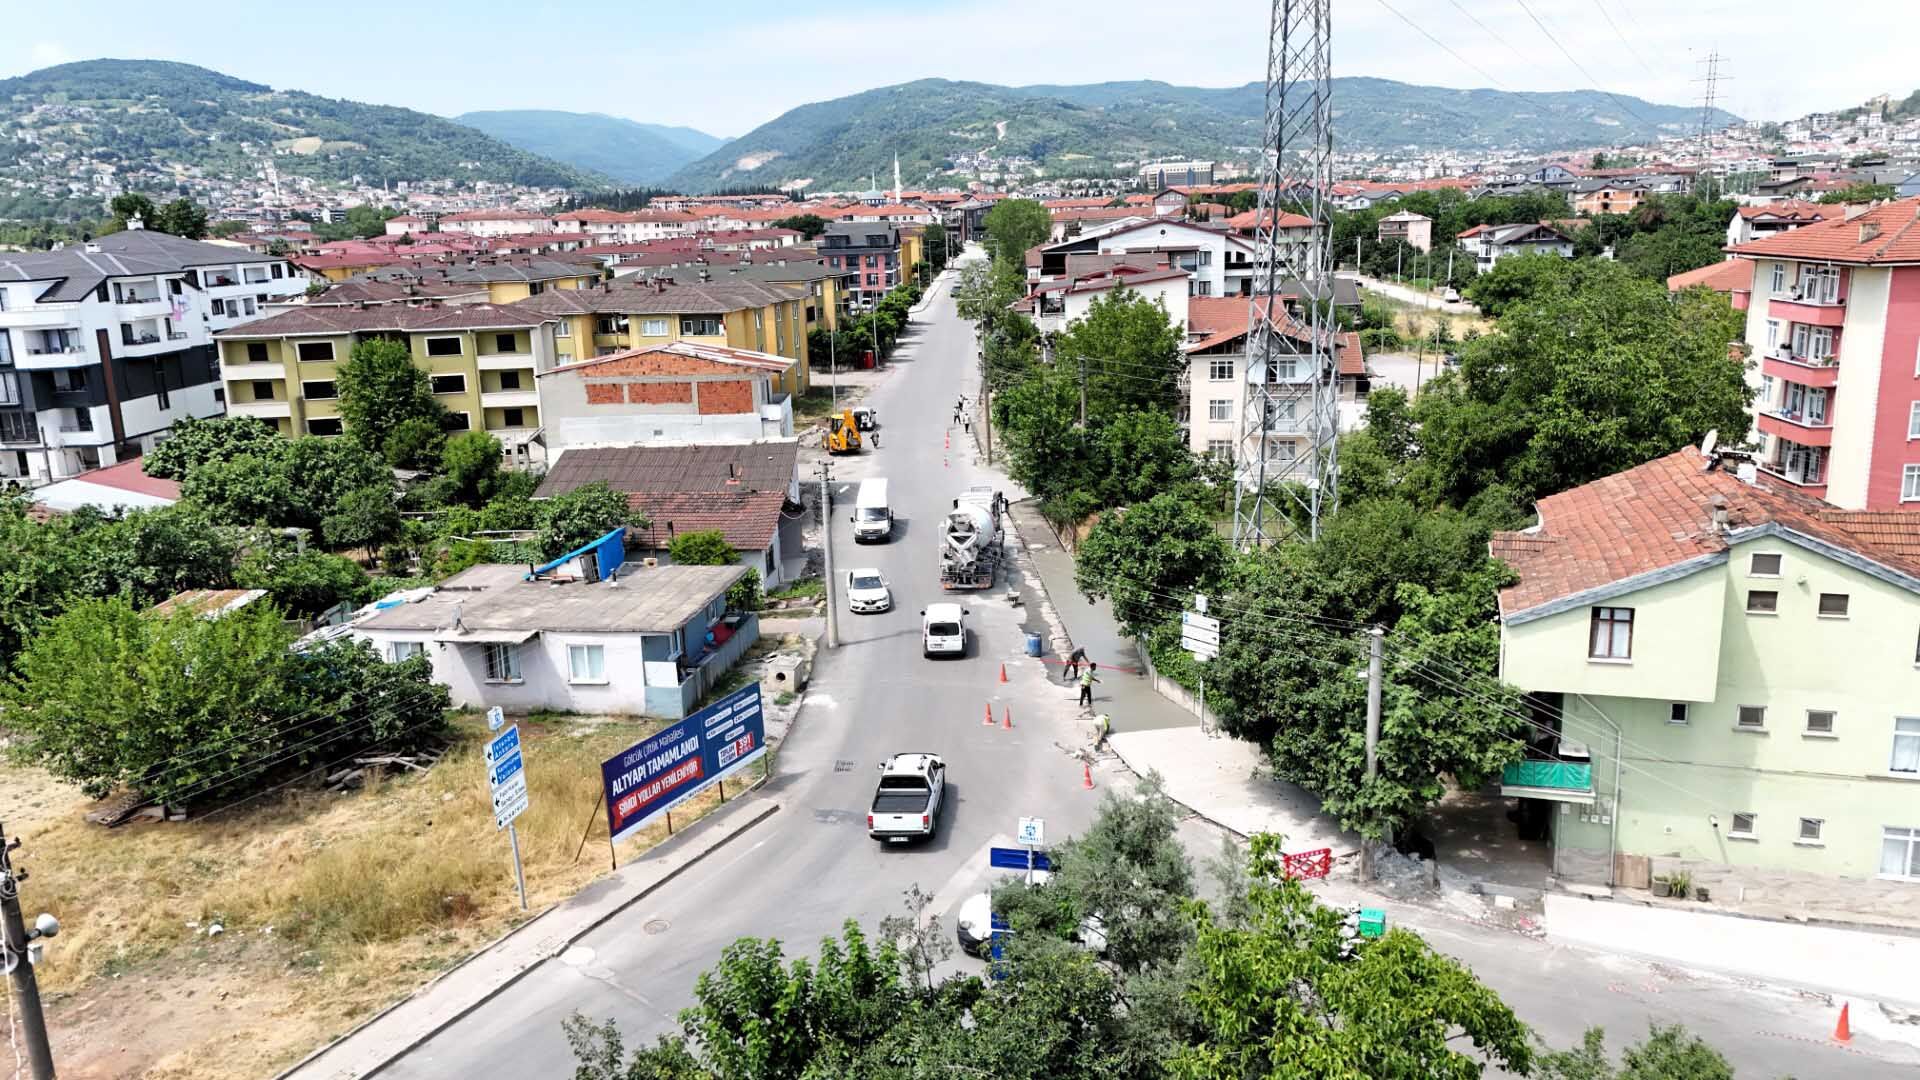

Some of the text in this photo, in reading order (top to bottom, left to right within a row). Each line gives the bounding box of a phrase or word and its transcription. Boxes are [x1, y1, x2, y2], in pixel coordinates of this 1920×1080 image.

[612, 764, 647, 797] ALTYAPI
[647, 734, 699, 776] TAMAMLANDI
[637, 782, 661, 804] YOLLAR
